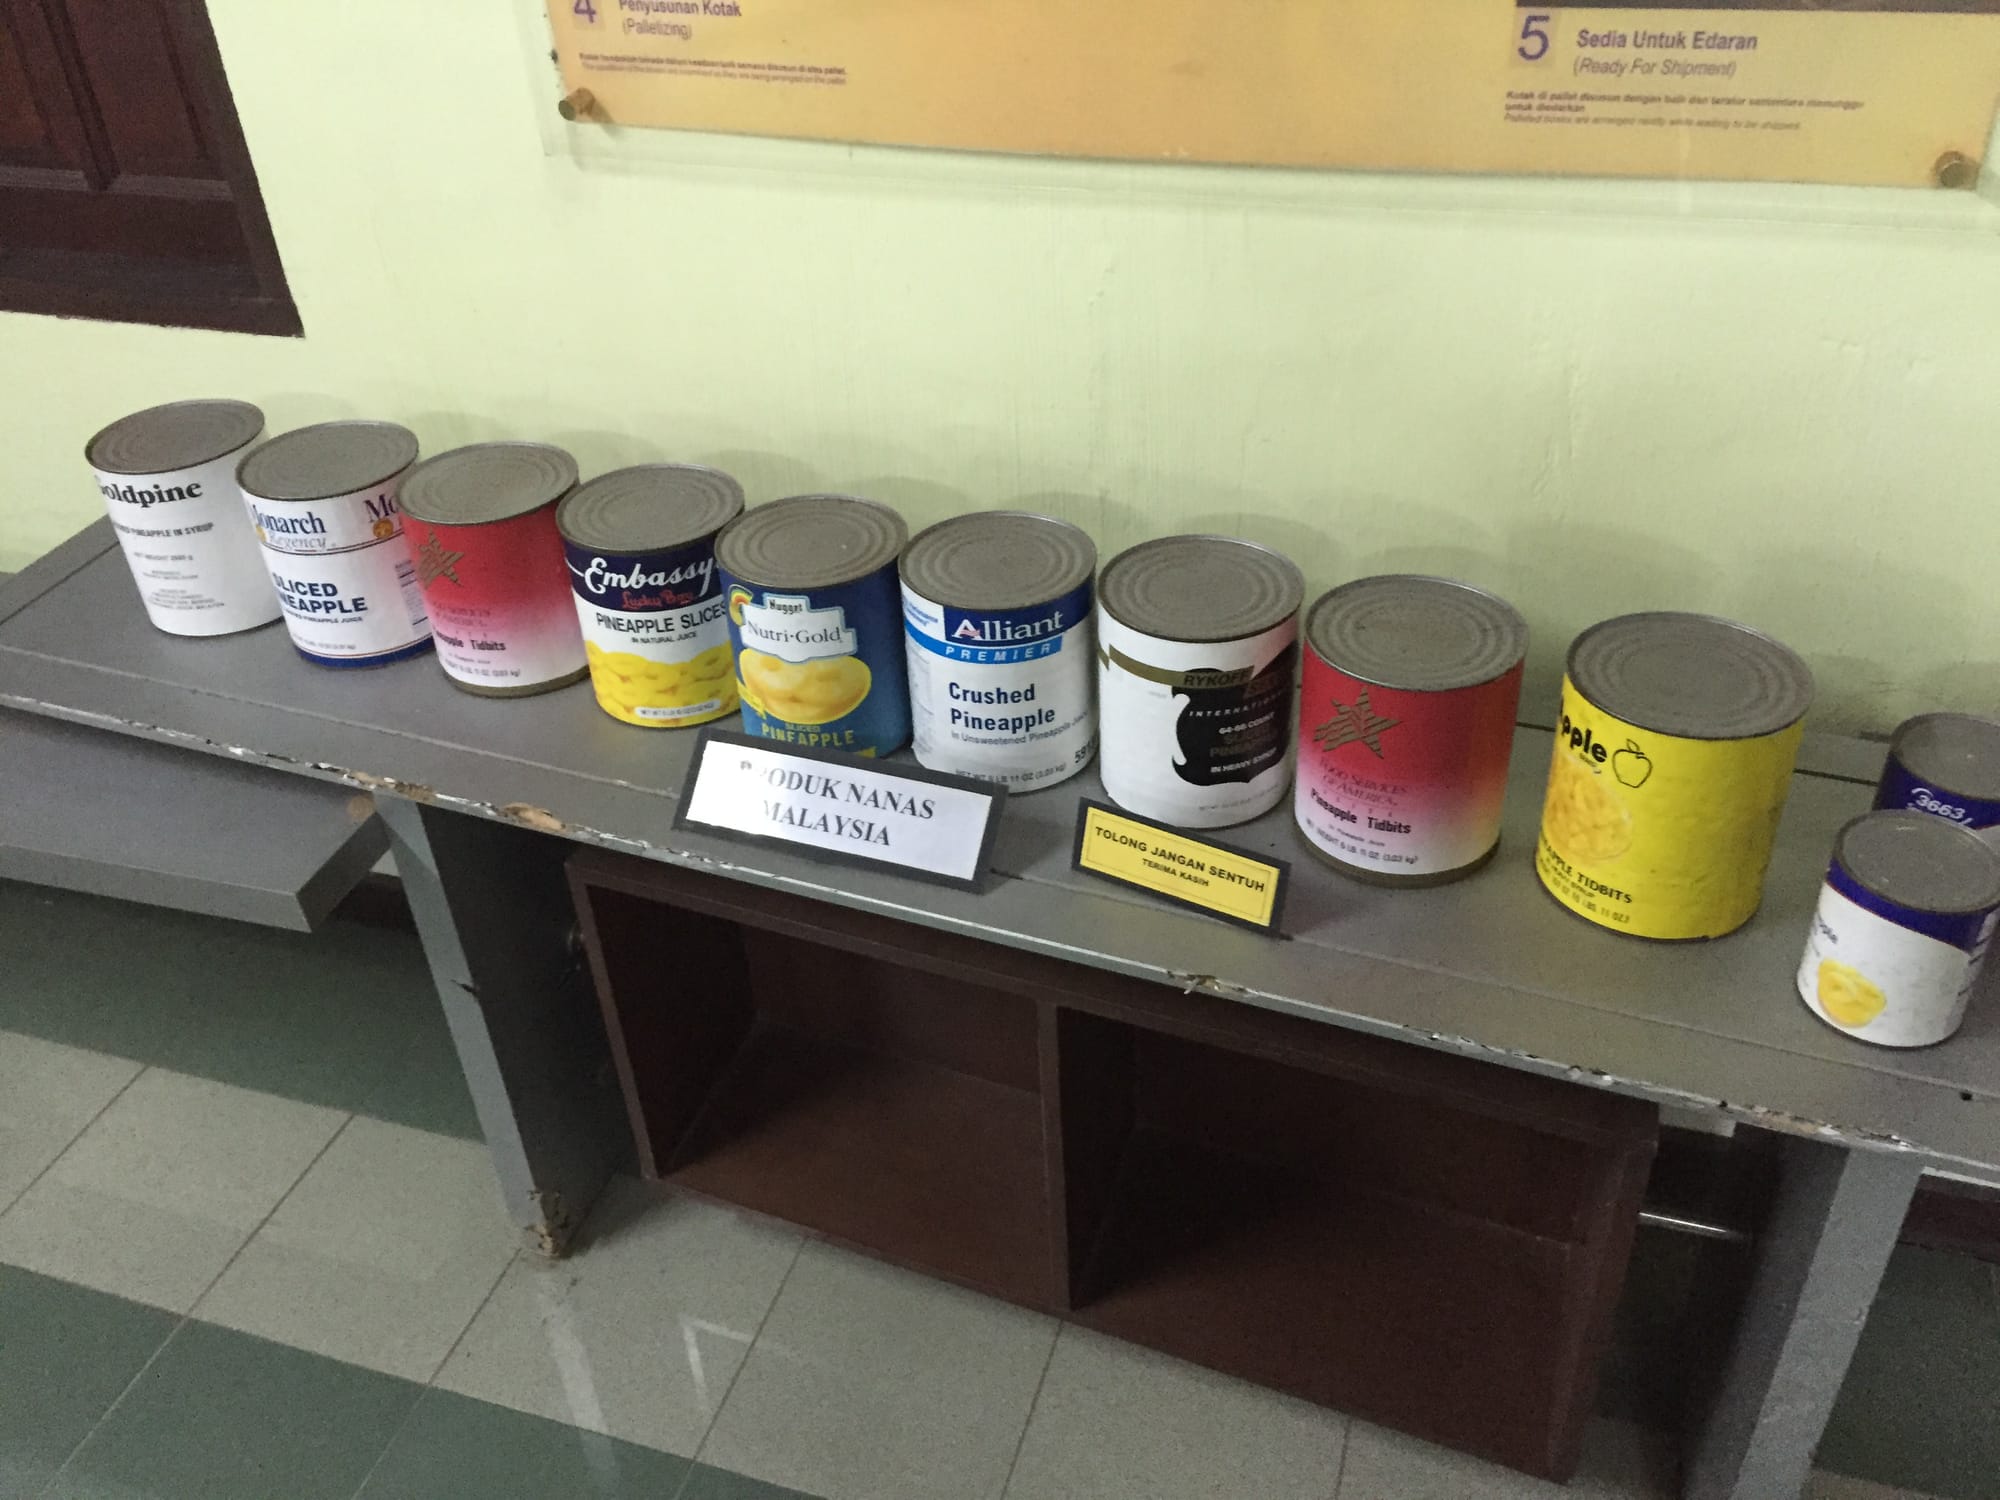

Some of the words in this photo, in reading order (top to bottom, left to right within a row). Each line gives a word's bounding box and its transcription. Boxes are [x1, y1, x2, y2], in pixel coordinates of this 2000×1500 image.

[703, 0, 743, 18] Kotak
[623, 18, 693, 40] (Palletizing)
[1517, 14, 1551, 62] 5
[1576, 29, 1627, 50] Sedia
[1632, 30, 1687, 51] Untuk
[1693, 32, 1758, 52] Edaran
[1572, 57, 1627, 78] (Ready
[1631, 58, 1656, 76] For
[1660, 59, 1738, 80] Shipment)
[584, 556, 715, 598] Embassy
[769, 598, 803, 615] Nugget
[596, 612, 675, 634] PINEAPPLE
[951, 610, 1063, 642] Alliant
[470, 639, 507, 651] Tidbits
[640, 636, 675, 645] NATURAL
[677, 631, 697, 643] JUICE
[946, 643, 1051, 662] PREMIER
[949, 682, 1036, 705] Crushed
[951, 708, 1056, 734] Pineapple
[761, 722, 855, 747] PINEAPPLE
[846, 782, 936, 820] NANAS
[1310, 786, 1358, 824] Pineapple
[1367, 815, 1412, 835] Tidbits
[1915, 794, 1966, 820] 3663
[763, 799, 891, 847] MALAYSIA
[1095, 826, 1148, 853] TOLONG
[1150, 847, 1206, 872] JANGAN
[1208, 865, 1266, 893] SENTUH
[1142, 858, 1178, 876] TERIMA
[1179, 871, 1210, 888] KASIH
[1577, 871, 1633, 904] TIDBITS
